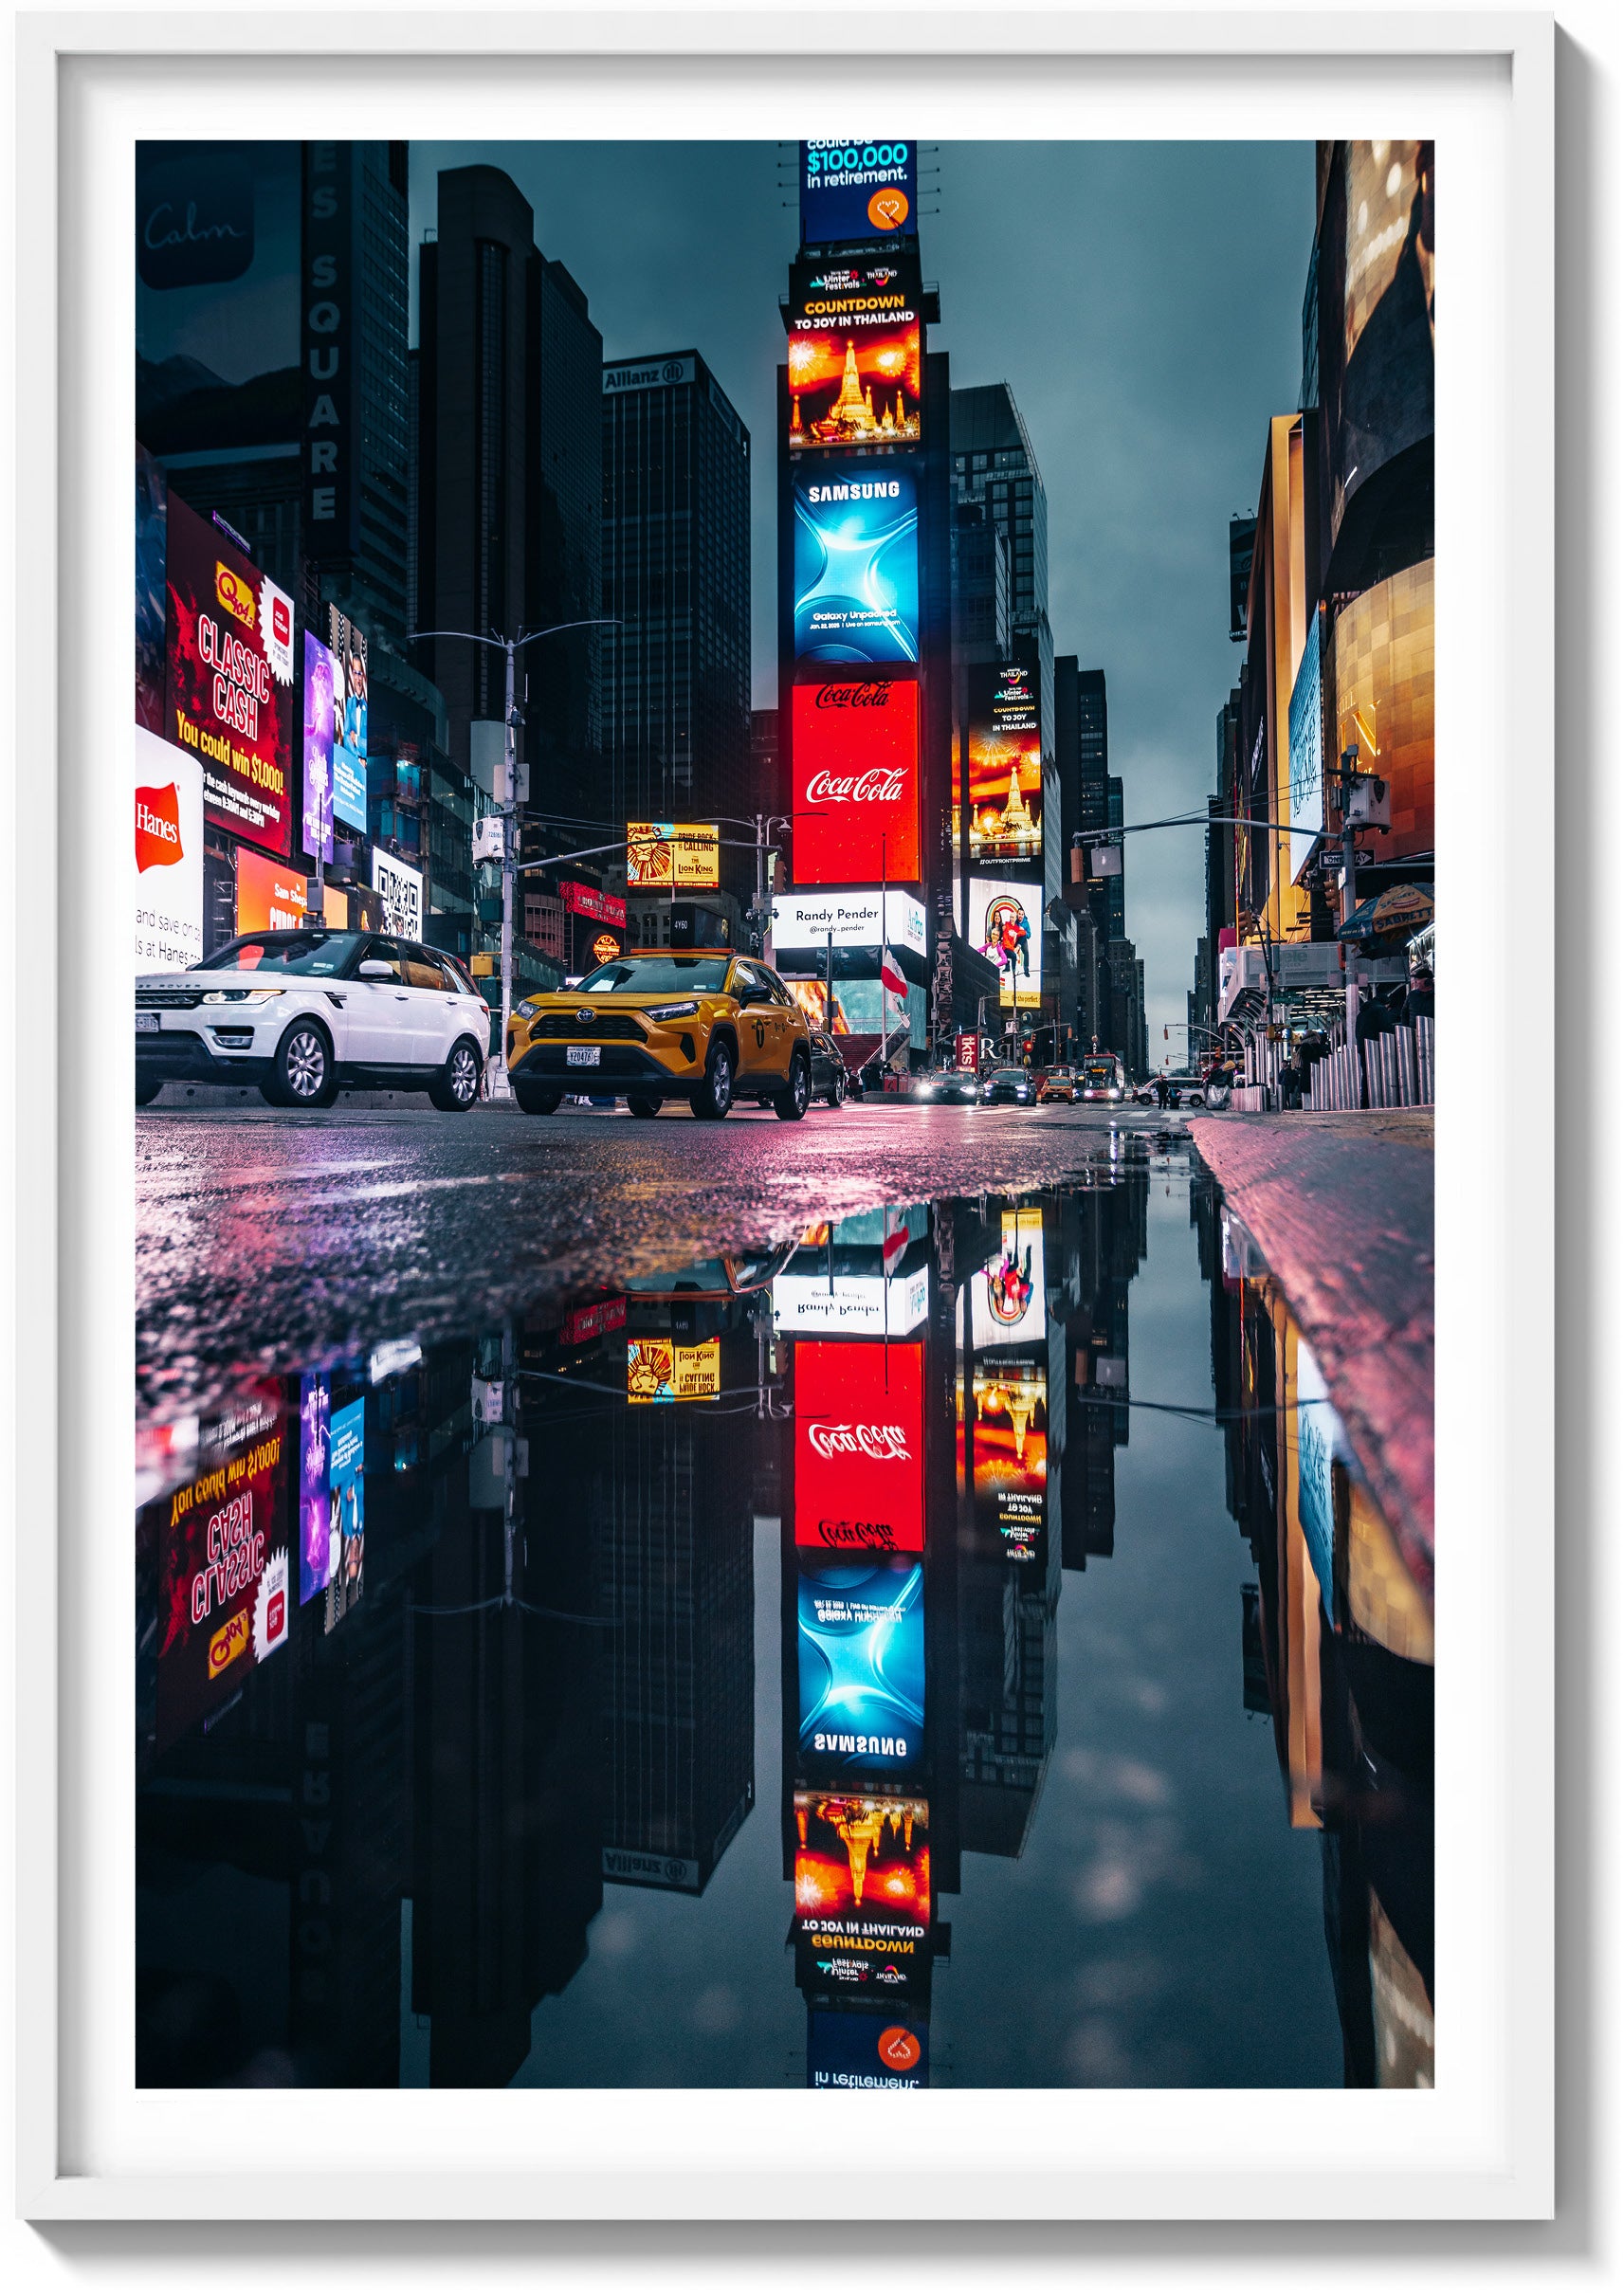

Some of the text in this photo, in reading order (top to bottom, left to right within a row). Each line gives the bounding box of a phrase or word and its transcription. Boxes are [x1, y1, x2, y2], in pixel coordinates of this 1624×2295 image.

[808, 143, 908, 174] $100,000
[807, 166, 907, 189] in retirement.
[144, 201, 248, 249] Calm
[805, 295, 904, 315] COUNTDOWN
[794, 311, 915, 330] TO JOY IN THAILAND
[308, 255, 341, 520] SQUARE
[605, 369, 660, 389] Allianz
[809, 481, 900, 502] SAMSUNG
[812, 609, 897, 622] Galaxy Unpacked
[198, 613, 270, 704] CLASSIC
[213, 673, 258, 741] CASH
[1001, 722, 1036, 731] THAILAND
[176, 708, 198, 748] You
[200, 731, 230, 766] could
[231, 747, 250, 777] win
[251, 753, 283, 796] $1,000!
[207, 772, 215, 788] the
[215, 778, 227, 792] cash
[806, 767, 909, 803] Coca-Cola
[204, 789, 223, 807] etween
[136, 803, 178, 844] Hanes
[684, 842, 714, 851] CALLING
[274, 883, 289, 900] Sam
[137, 909, 155, 927] and
[158, 916, 179, 934] save
[182, 922, 192, 937] on
[796, 907, 879, 922] Randy Pender
[674, 920, 688, 930] 4Y60
[810, 924, 865, 934] @randy_pender
[146, 941, 155, 957] at
[961, 1036, 976, 1066] tkts
